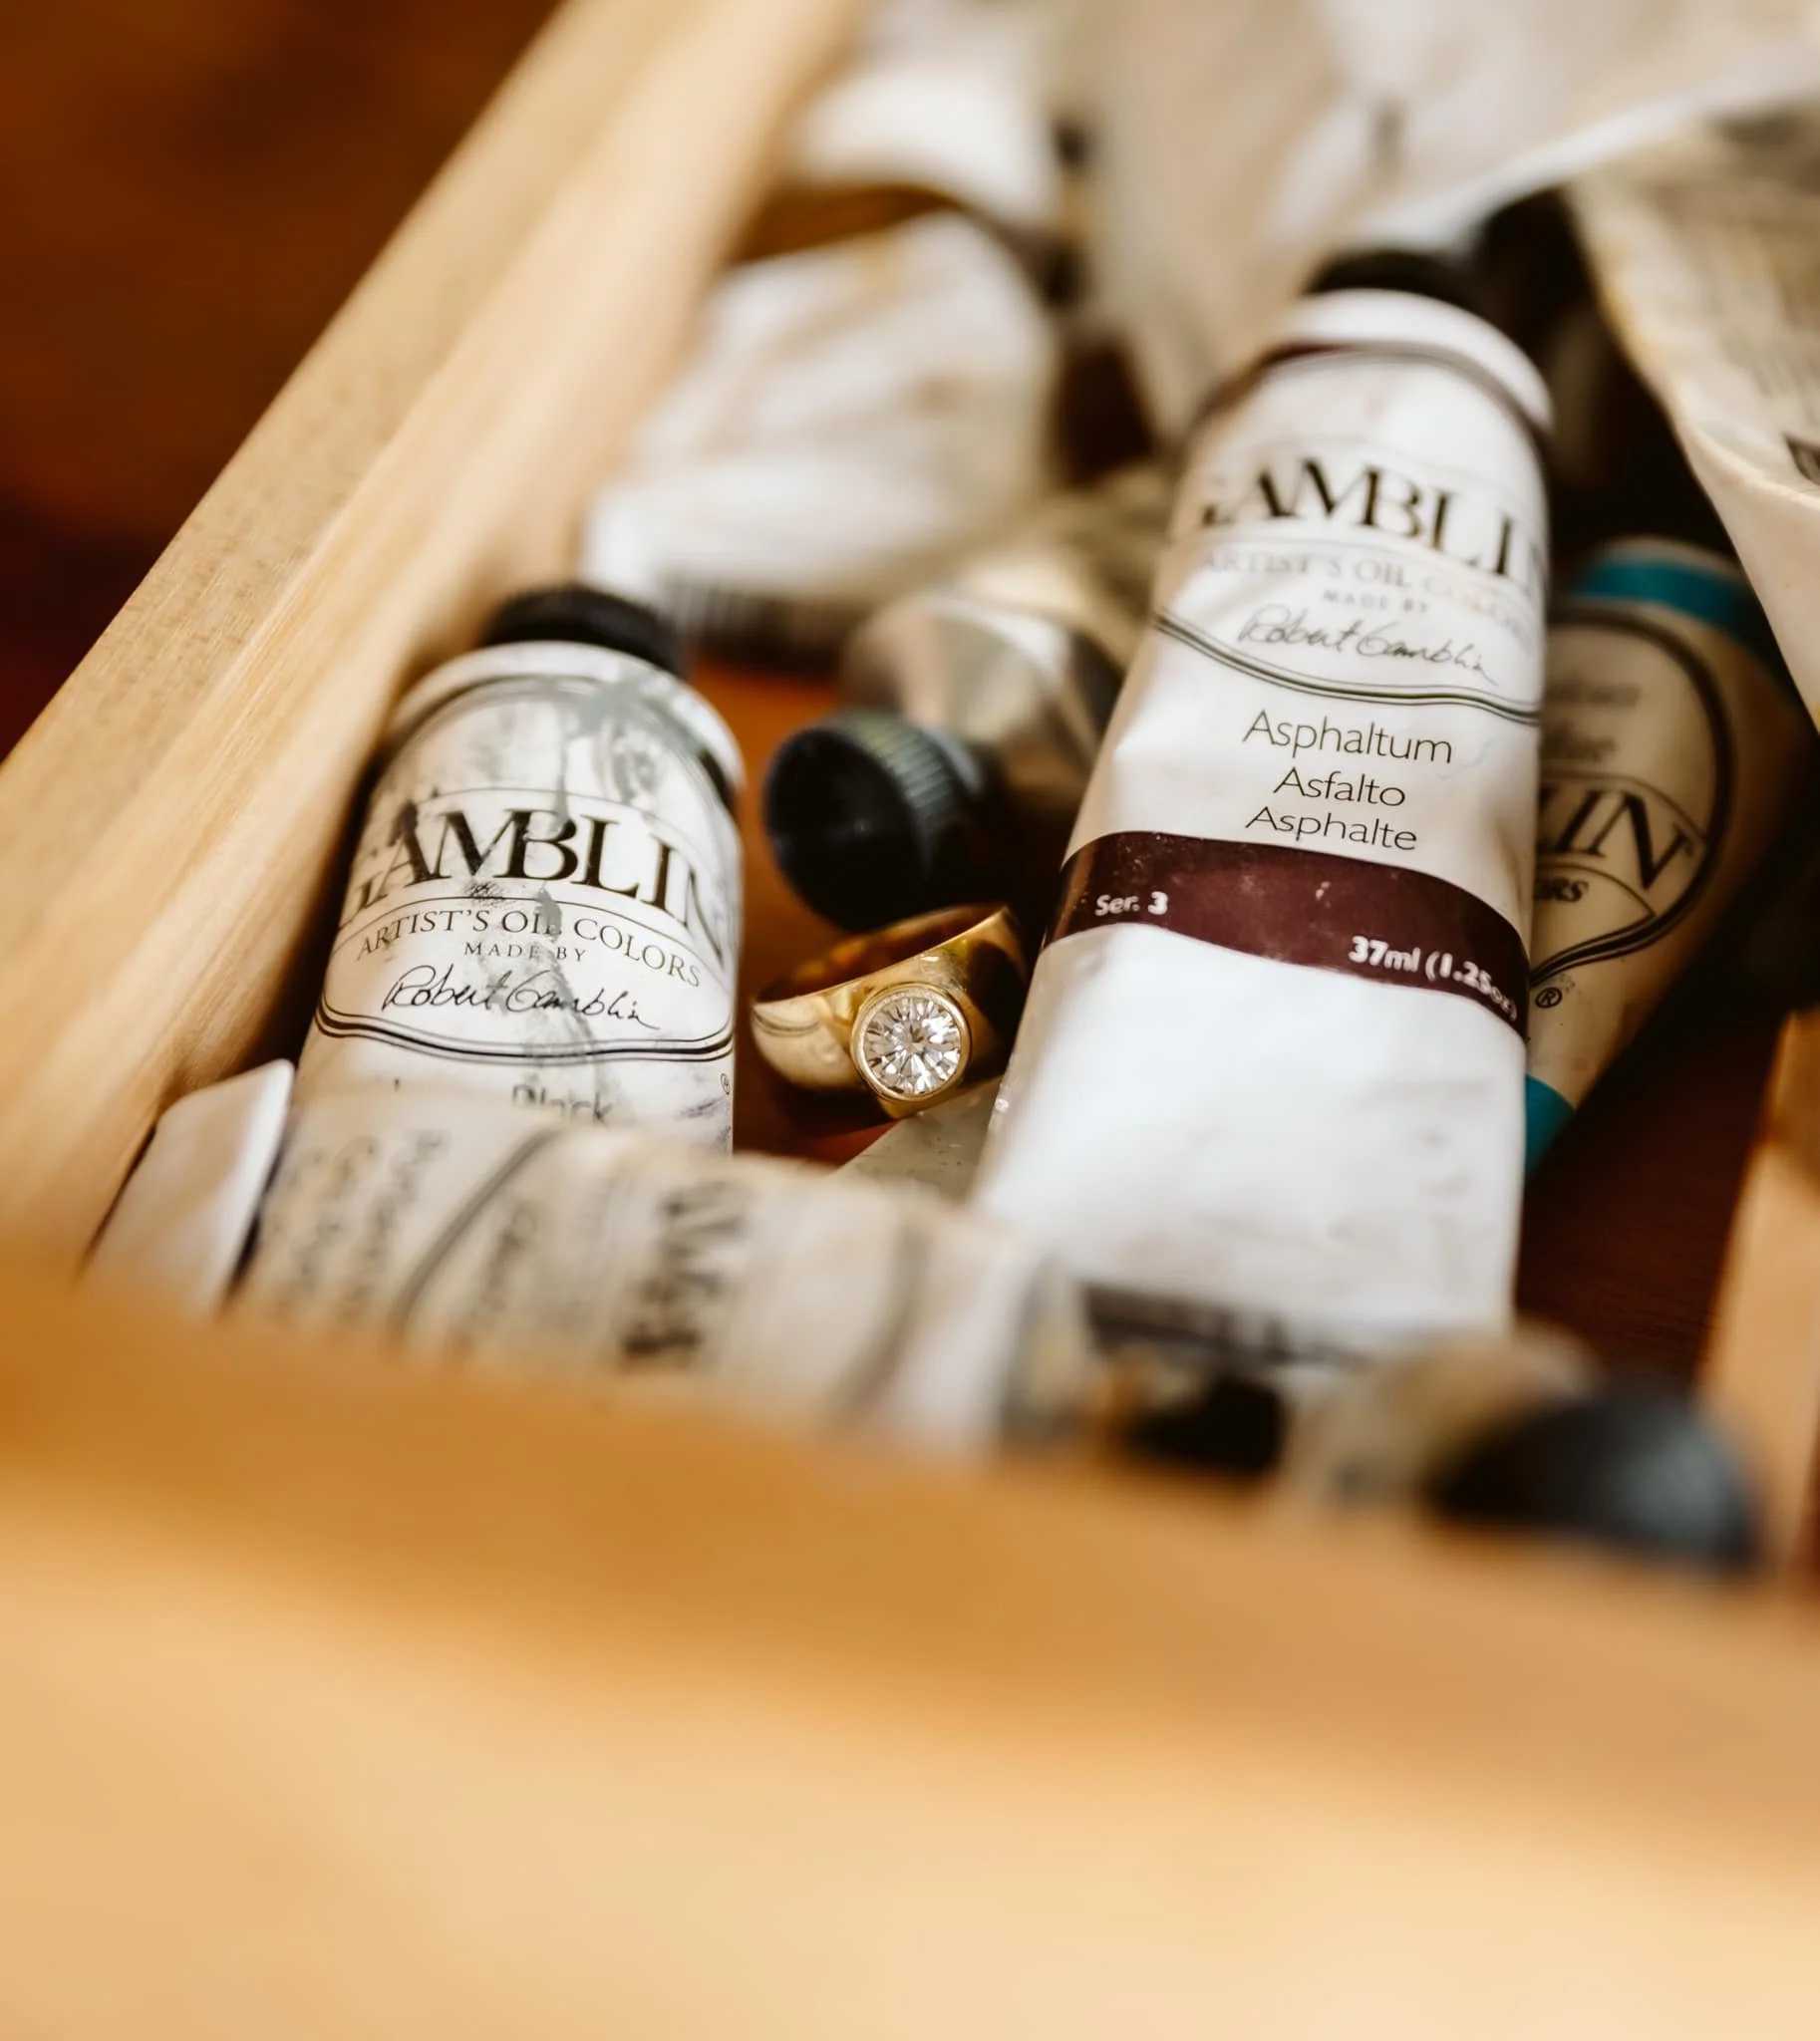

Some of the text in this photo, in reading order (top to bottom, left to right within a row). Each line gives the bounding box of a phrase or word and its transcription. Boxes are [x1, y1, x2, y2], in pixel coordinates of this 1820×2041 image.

[1199, 457, 1547, 580] AMBLI
[1355, 557, 1415, 592] OIL
[1323, 586, 1430, 616] MADE BY
[1242, 709, 1453, 765] Asphaltum
[1273, 765, 1406, 808] Asfalto
[1244, 804, 1418, 852] Asphalte
[1095, 891, 1170, 918] Ser. 3
[358, 908, 701, 988] ARTIST'S OIL COLORS
[463, 940, 586, 963] MADE BY
[1348, 935, 1422, 974] 37ml
